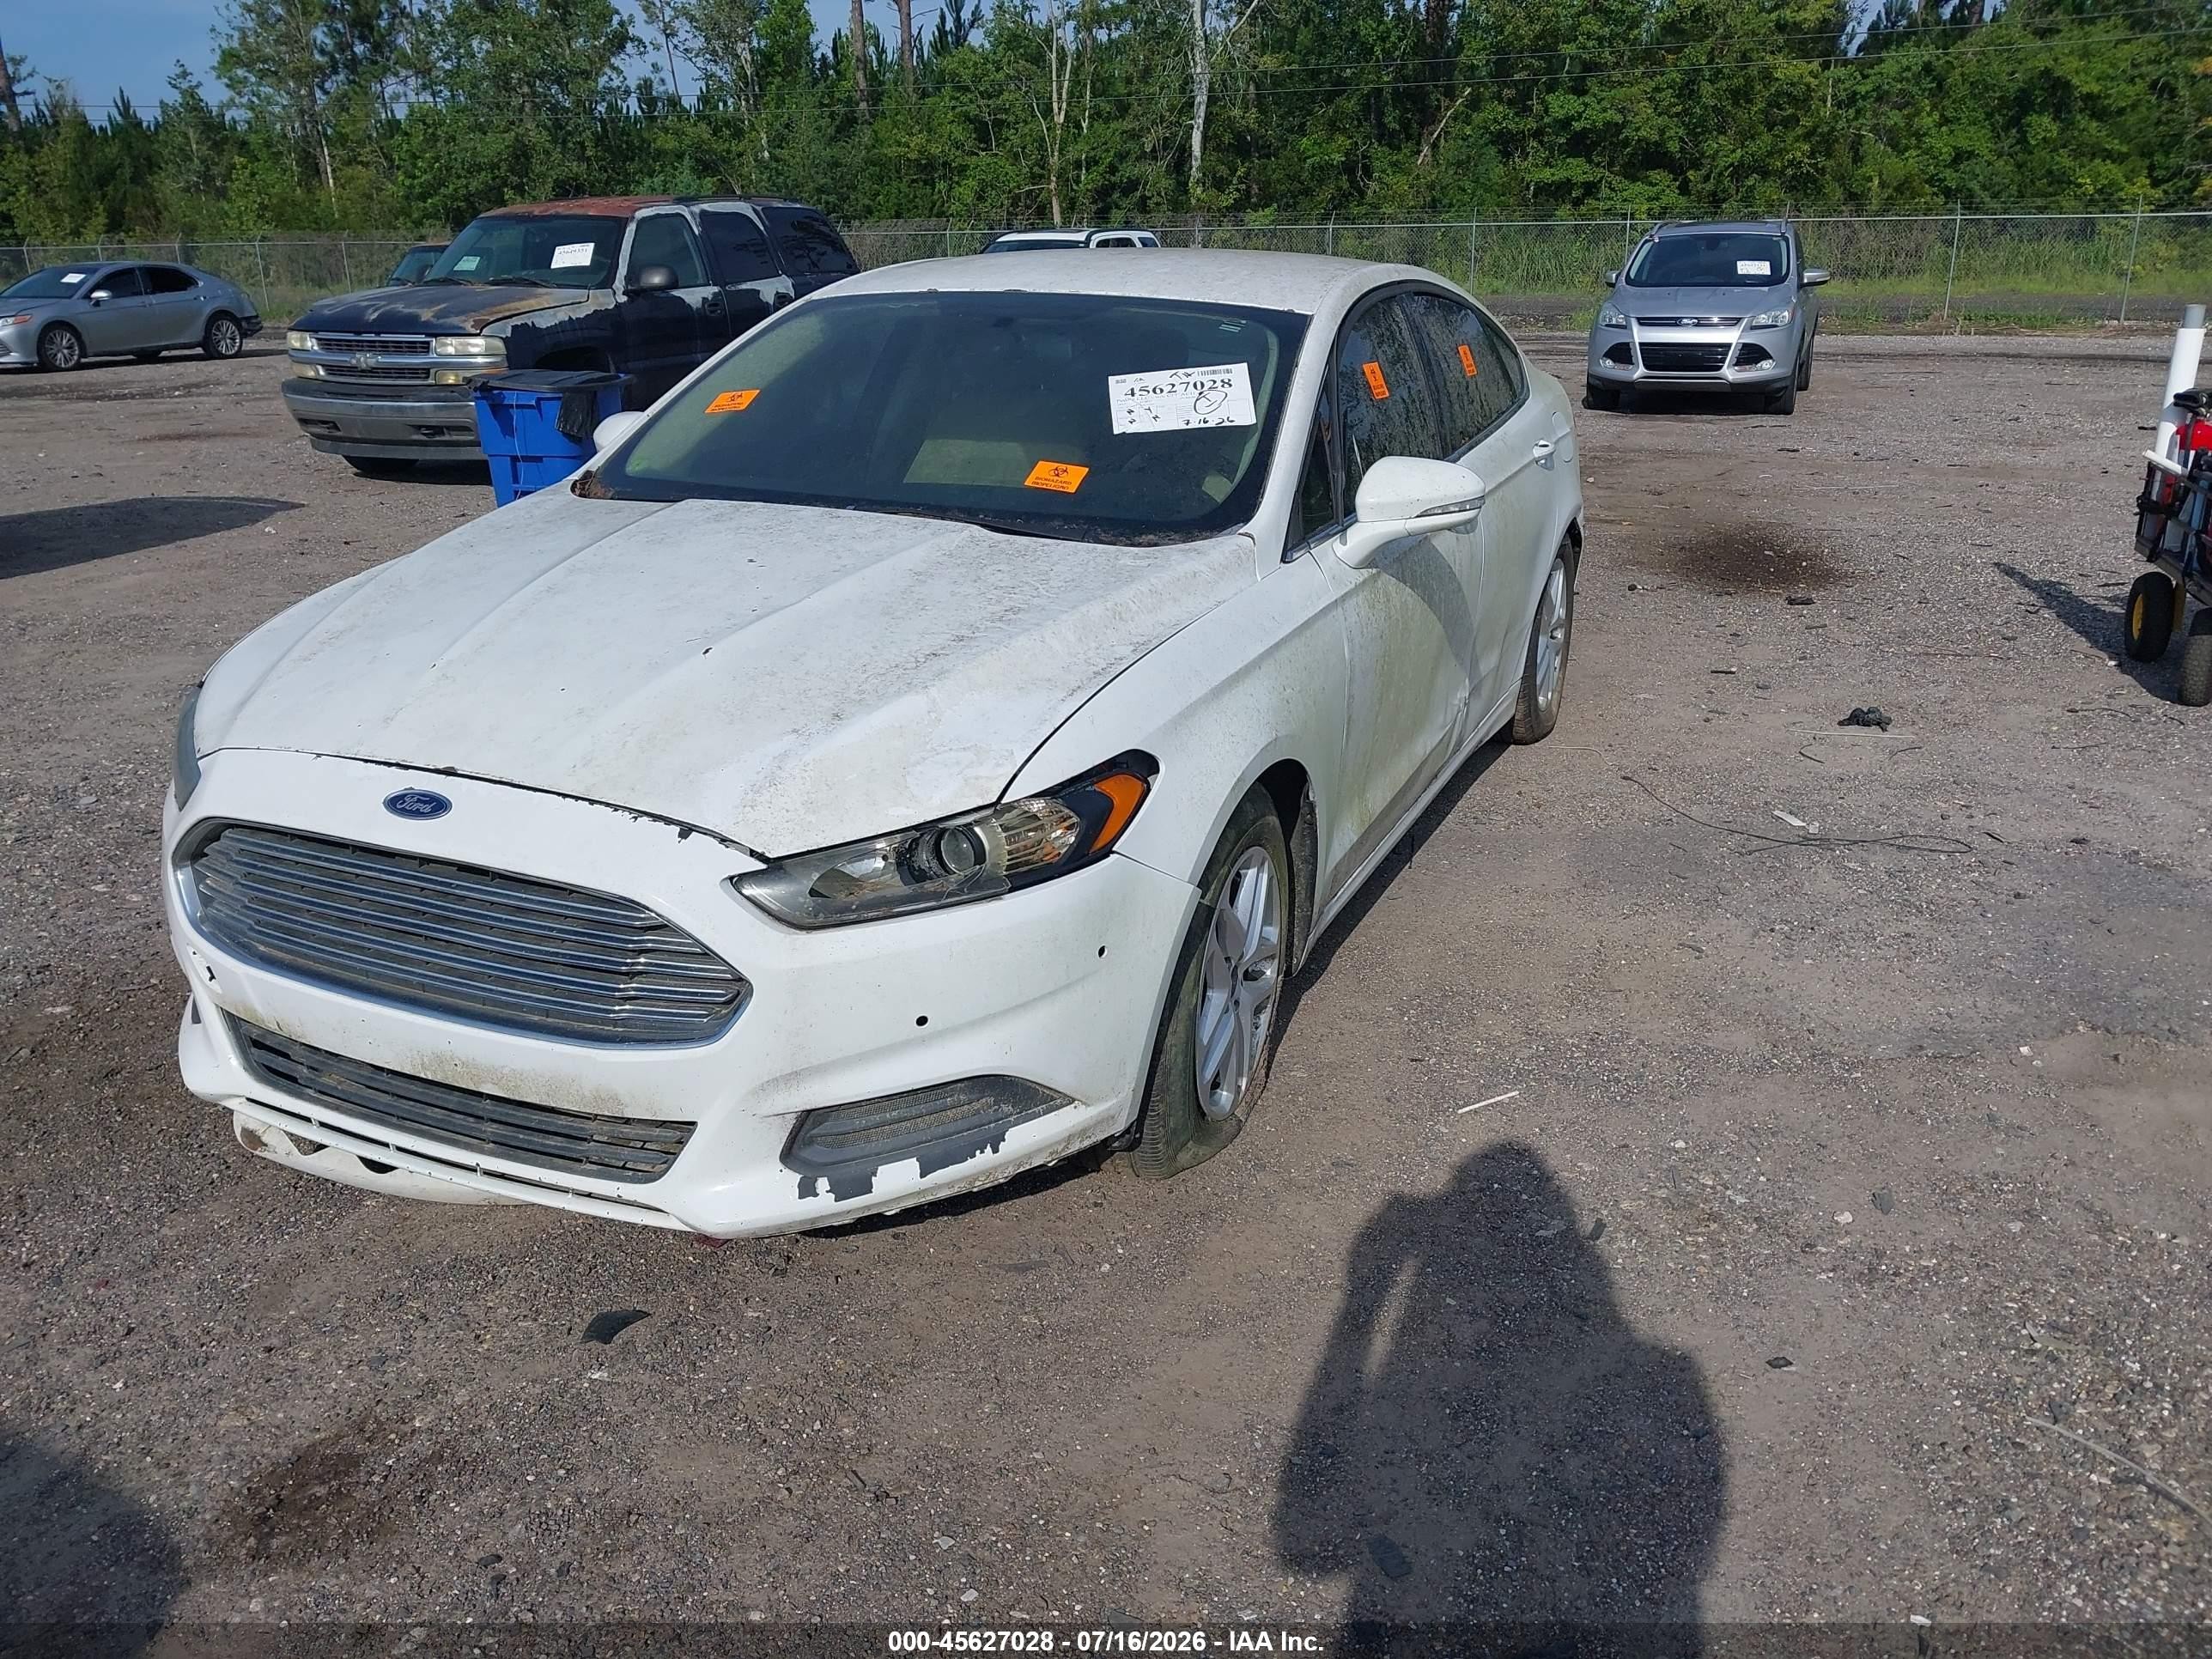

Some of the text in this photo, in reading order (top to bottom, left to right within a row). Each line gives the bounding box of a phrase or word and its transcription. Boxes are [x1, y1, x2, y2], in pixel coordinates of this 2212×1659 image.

[1124, 378, 1233, 398] 45627028
[1035, 476, 1072, 485] BIOHAZARD
[396, 794, 437, 813] Ford
